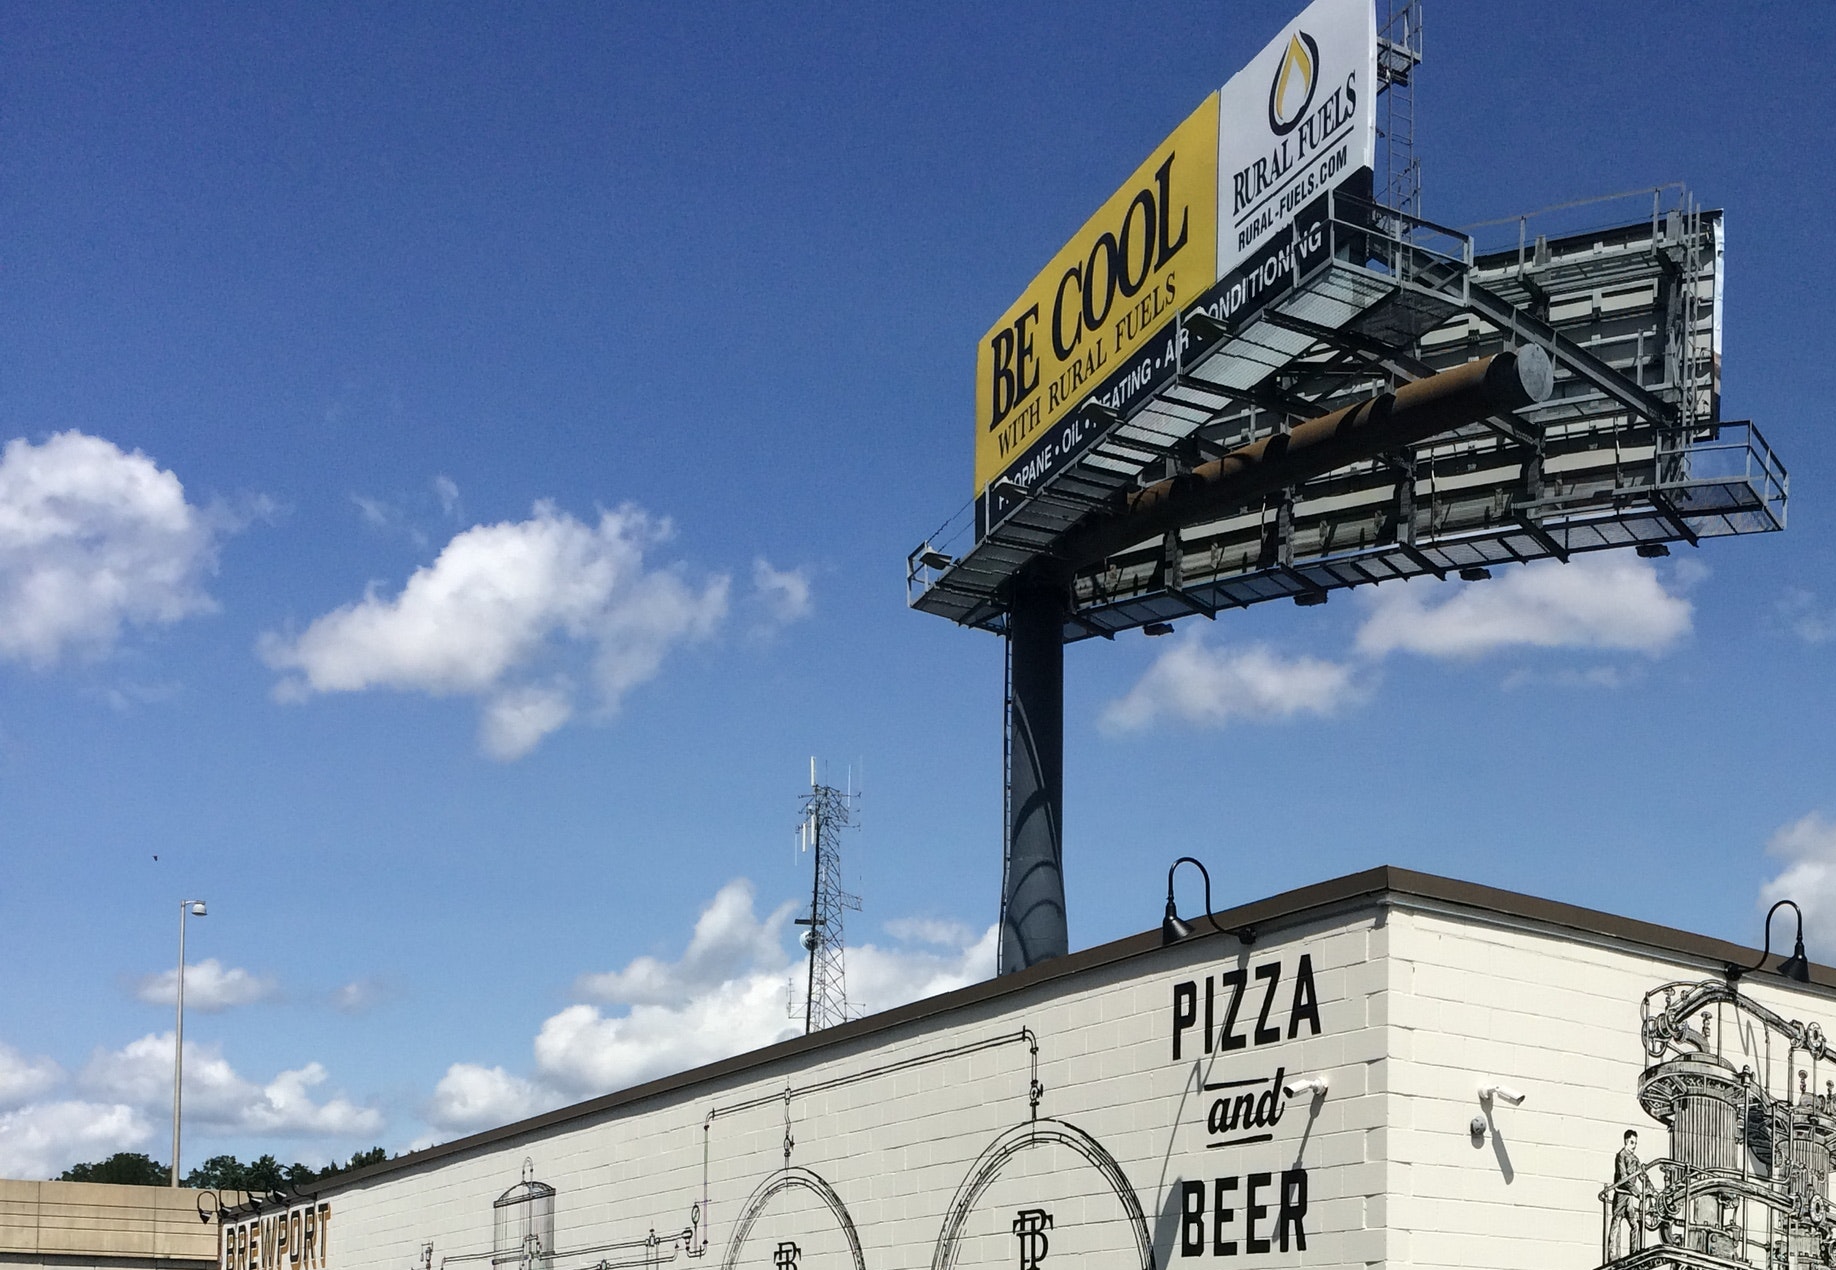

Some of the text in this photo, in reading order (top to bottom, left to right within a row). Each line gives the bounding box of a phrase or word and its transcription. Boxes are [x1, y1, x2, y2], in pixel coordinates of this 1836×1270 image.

[1233, 70, 1356, 216] RURAL FUELS
[1239, 145, 1347, 252] RURAL-FUELS.COM
[990, 150, 1188, 433] BE COOL
[998, 271, 1175, 458] WITH RURAL FUELS
[1062, 420, 1082, 453] OIL
[1173, 954, 1321, 1061] PIZZA
[1208, 1067, 1285, 1135] and
[1181, 1168, 1307, 1257] BEER
